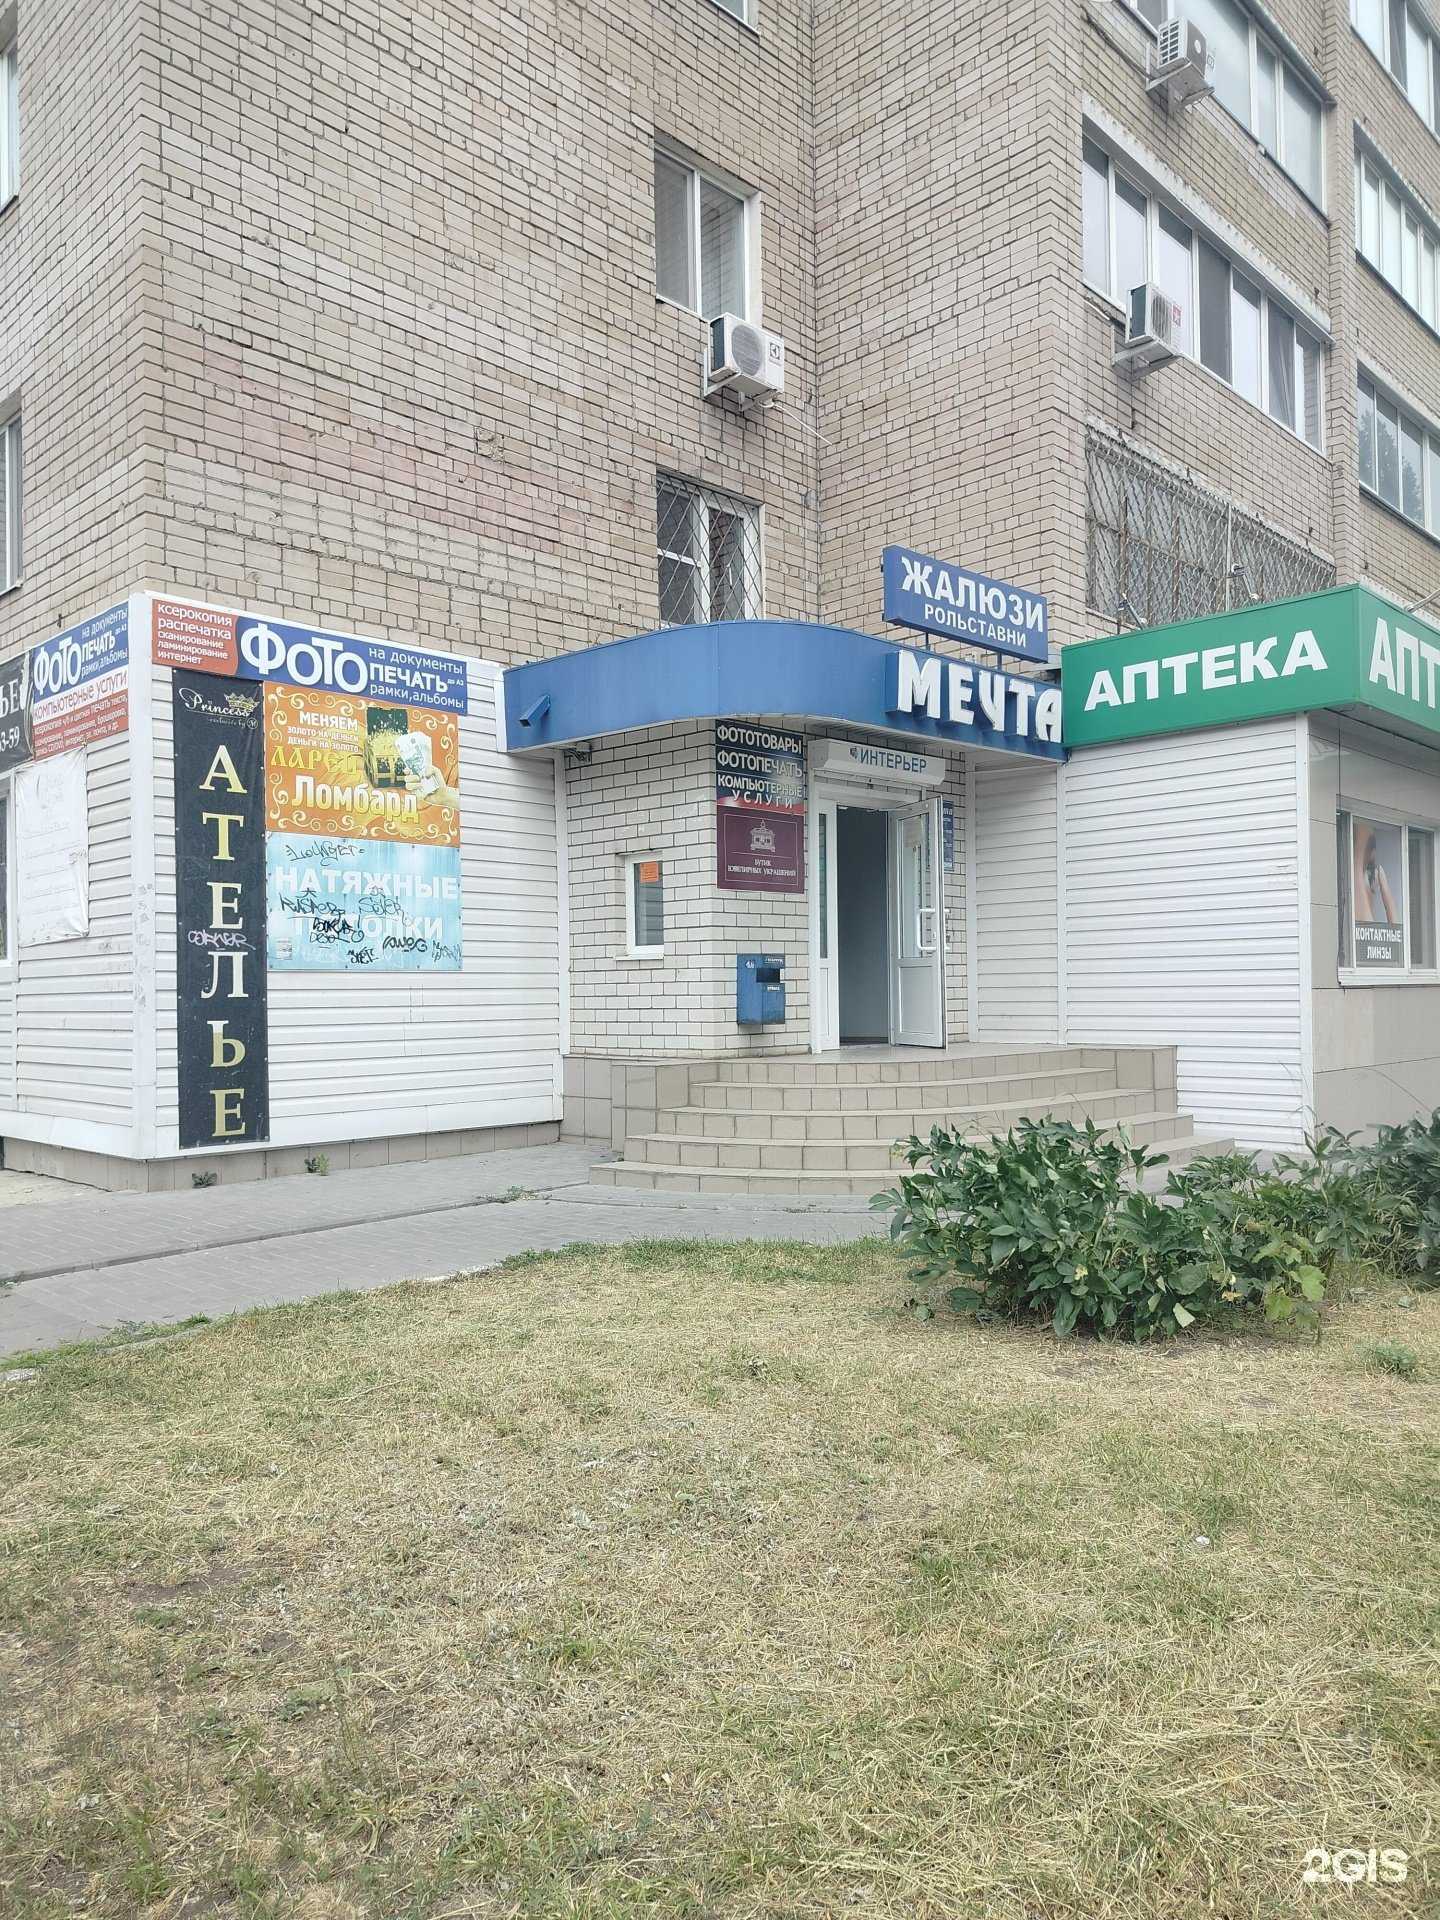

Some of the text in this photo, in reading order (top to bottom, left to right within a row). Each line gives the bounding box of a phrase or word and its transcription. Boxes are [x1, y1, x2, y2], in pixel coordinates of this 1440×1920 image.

[901, 556, 1044, 633] ЖАЛЮЗИ
[82, 609, 128, 639] на документы
[158, 603, 232, 627] ксерокопия
[158, 617, 231, 640] распечатка
[925, 604, 1026, 648] РОЛЬСТАВНИ
[82, 631, 115, 662] ПЕЧАТЬ
[158, 631, 224, 649] сканирование
[158, 641, 228, 659] ламинирование
[34, 636, 81, 695] ФОТО
[158, 651, 202, 664] интернет
[241, 623, 368, 693] ФОТО
[369, 648, 463, 675] на документы
[1084, 630, 1328, 711] АПТЕКА
[1369, 617, 1440, 709] АПТ
[370, 663, 448, 693] ПЕЧАТЬ
[179, 688, 251, 716] Princess
[898, 650, 1062, 743] МЕЧТА
[287, 727, 317, 737] ЗОЛОТО
[300, 711, 358, 731] МЕНЯЕМ
[287, 737, 359, 752] ДЕНЬГИ НА ЗОЛОТО
[717, 725, 802, 754] ФОТОТОВАРЫ
[717, 750, 802, 777] ФОТОПЕЧАТЬ
[861, 748, 927, 773] ИНТЕРЬЕР
[291, 775, 420, 823] Ломбард
[718, 774, 802, 797] КОМПЬЮТЕРНЫЕ
[732, 789, 792, 808] УСЛУГИ
[275, 866, 459, 899] НАТЯЖНЫЕ
[728, 865, 761, 874] ЮВЕЛИРНЫХ
[199, 745, 248, 1137] АТЕЛЬЕ
[1355, 928, 1401, 942] КОНТАКТНЫЕ
[1367, 946, 1392, 959] ЛИНЗЫ
